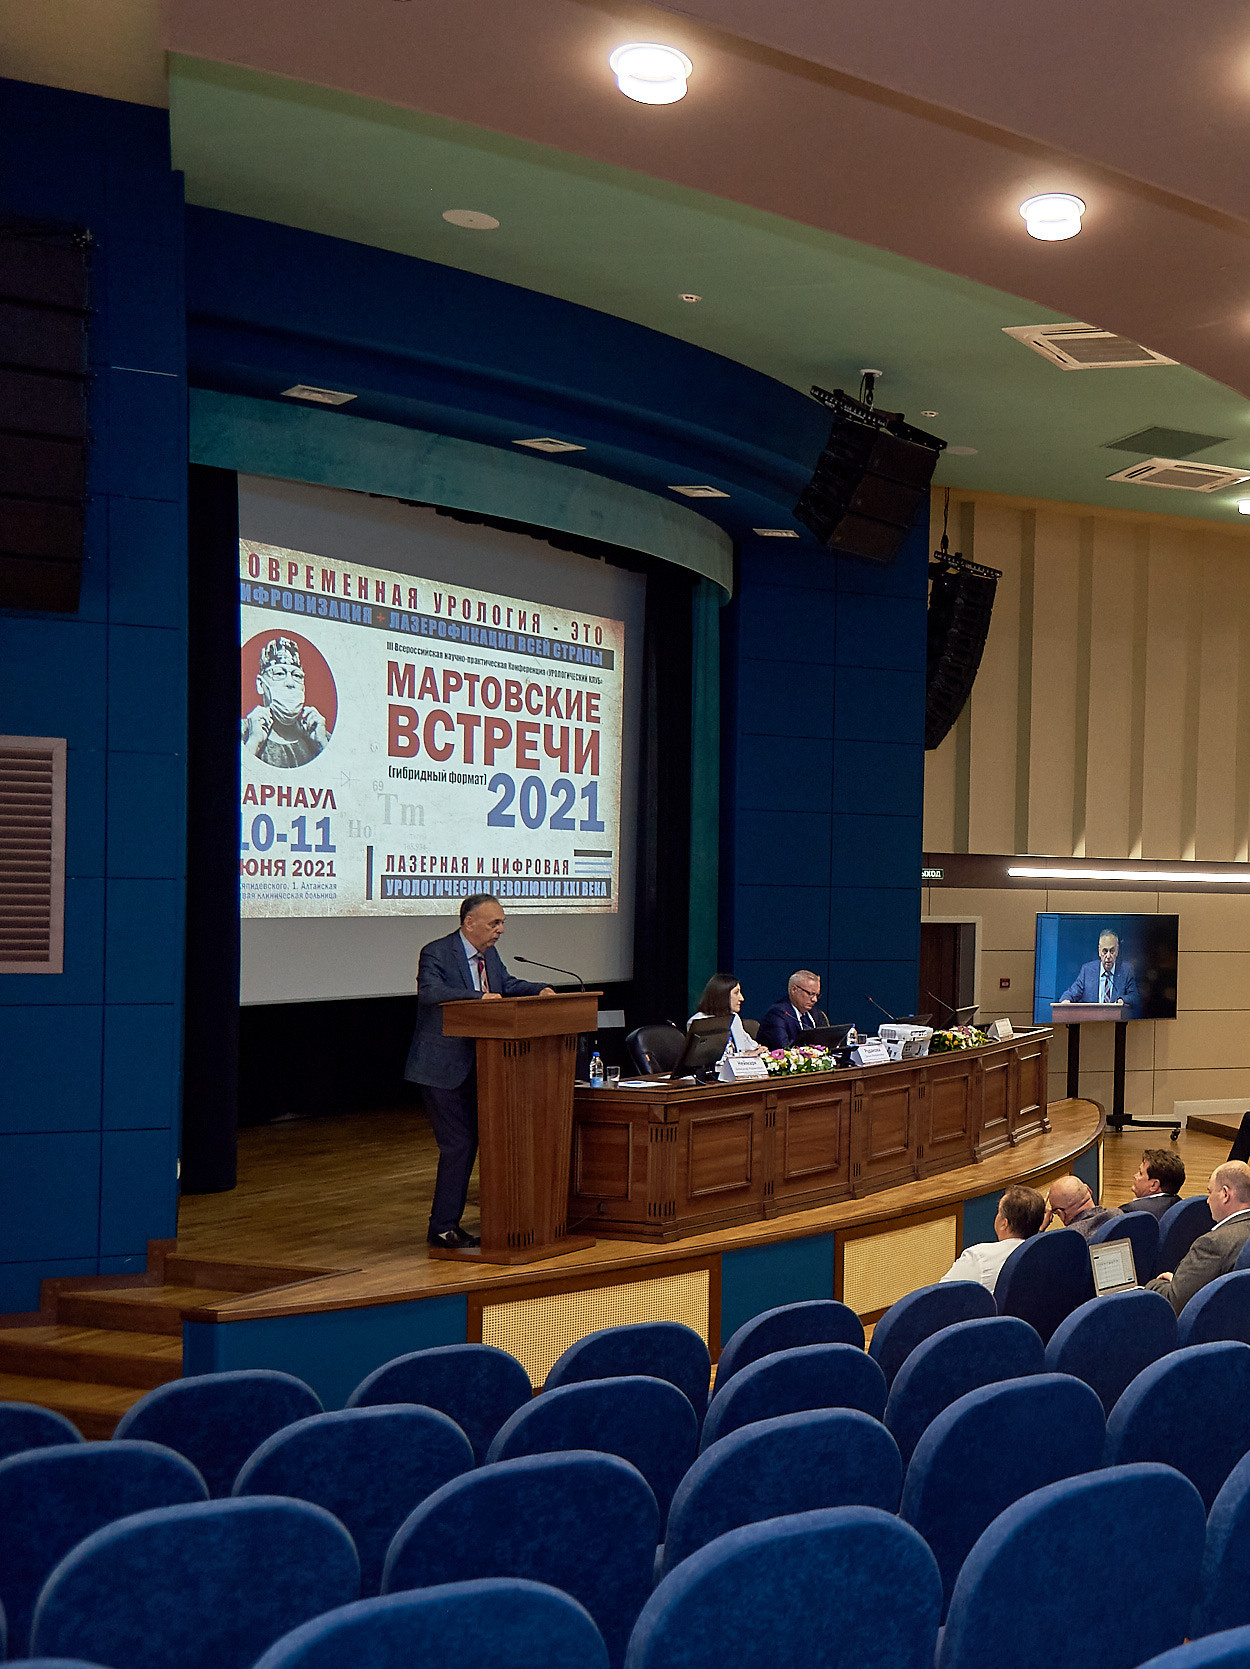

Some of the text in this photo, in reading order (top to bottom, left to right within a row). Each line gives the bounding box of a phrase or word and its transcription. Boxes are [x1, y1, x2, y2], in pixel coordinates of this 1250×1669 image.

[248, 553, 418, 610] ОВРЕМЕННАЯ
[433, 592, 541, 633] УРОЛОГИЯ
[570, 621, 603, 646] ЭТО
[240, 582, 372, 624] ИФРОВИЗАЦИЯ
[389, 611, 515, 650] ЛАЗЕРОФИКАЦИЯ
[518, 635, 550, 657] ВСЕЙ
[553, 642, 603, 666] СТРАНЫ
[394, 643, 443, 659] Всероссийская
[444, 653, 507, 669] научно-практическая
[387, 660, 601, 724] МАРТОВСКИЕ
[387, 703, 600, 776] ВСТРЕЧИ
[372, 780, 384, 792] 69
[388, 765, 487, 786] (гибридный формат)
[242, 783, 337, 810] АРНАУЛ
[487, 772, 605, 832] 2021
[377, 792, 425, 826] Tm
[348, 819, 372, 838] Ho
[240, 858, 336, 877] ЮНЯ 2021
[385, 854, 569, 877] ЛАЗЕРНАЯ И ЦИФРОВАЯ
[921, 870, 942, 878] ЫХОД
[242, 892, 337, 900] вая клиническая больница
[300, 881, 337, 891] Алтайская
[386, 879, 490, 897] УРОЛОГИЧЕСКАЯ
[492, 880, 561, 898] РЕВОЛЮЦИЯ
[581, 881, 607, 897] ВЕКА
